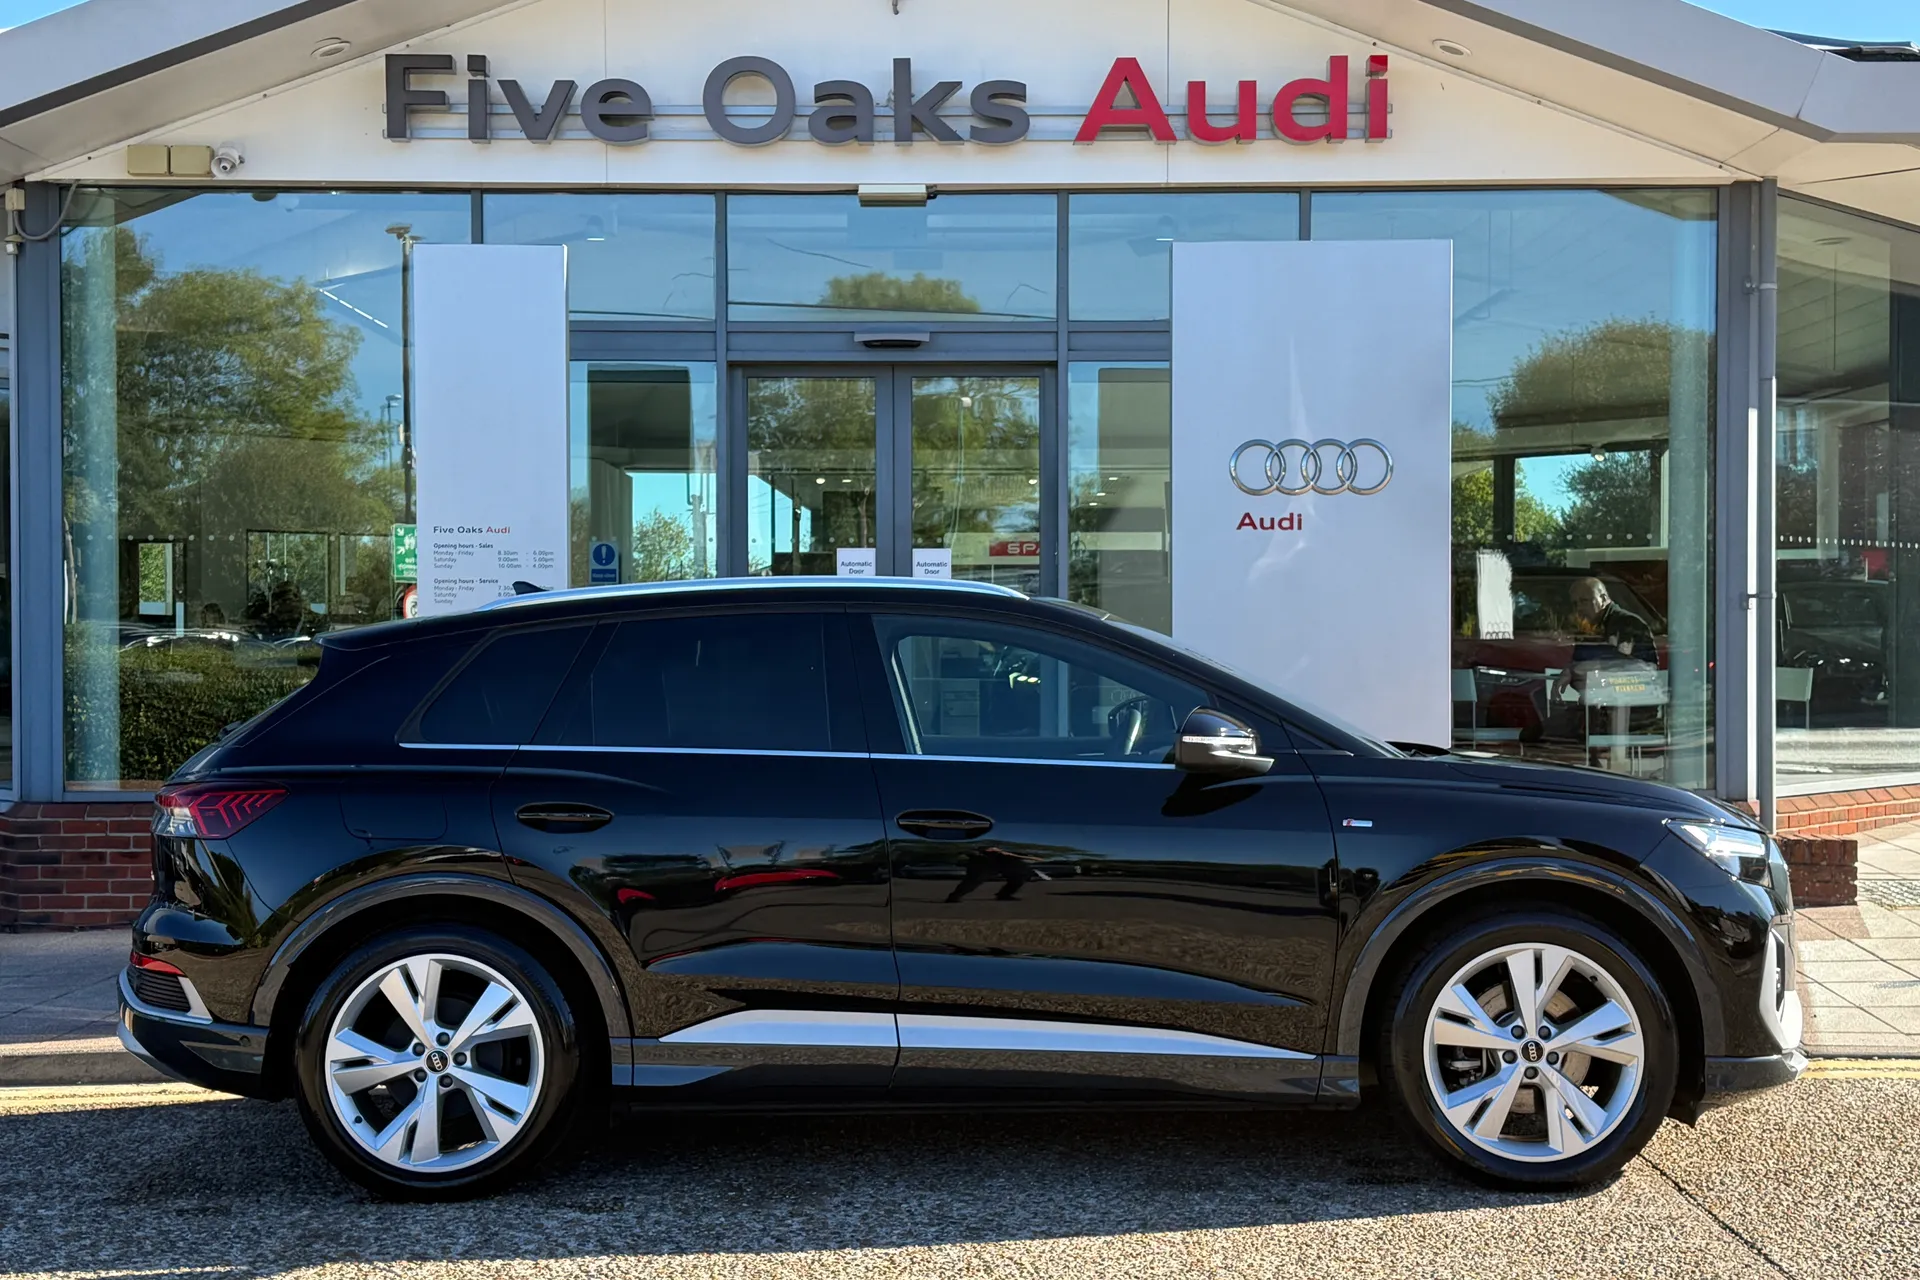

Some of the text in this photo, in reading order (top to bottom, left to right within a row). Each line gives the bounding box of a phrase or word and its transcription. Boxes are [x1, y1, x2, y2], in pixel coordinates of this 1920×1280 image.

[385, 54, 1389, 147] Five Oaks Audi
[1236, 512, 1303, 531] Audi
[433, 525, 511, 534] Five Oaks Audi
[1007, 542, 1039, 554] SP
